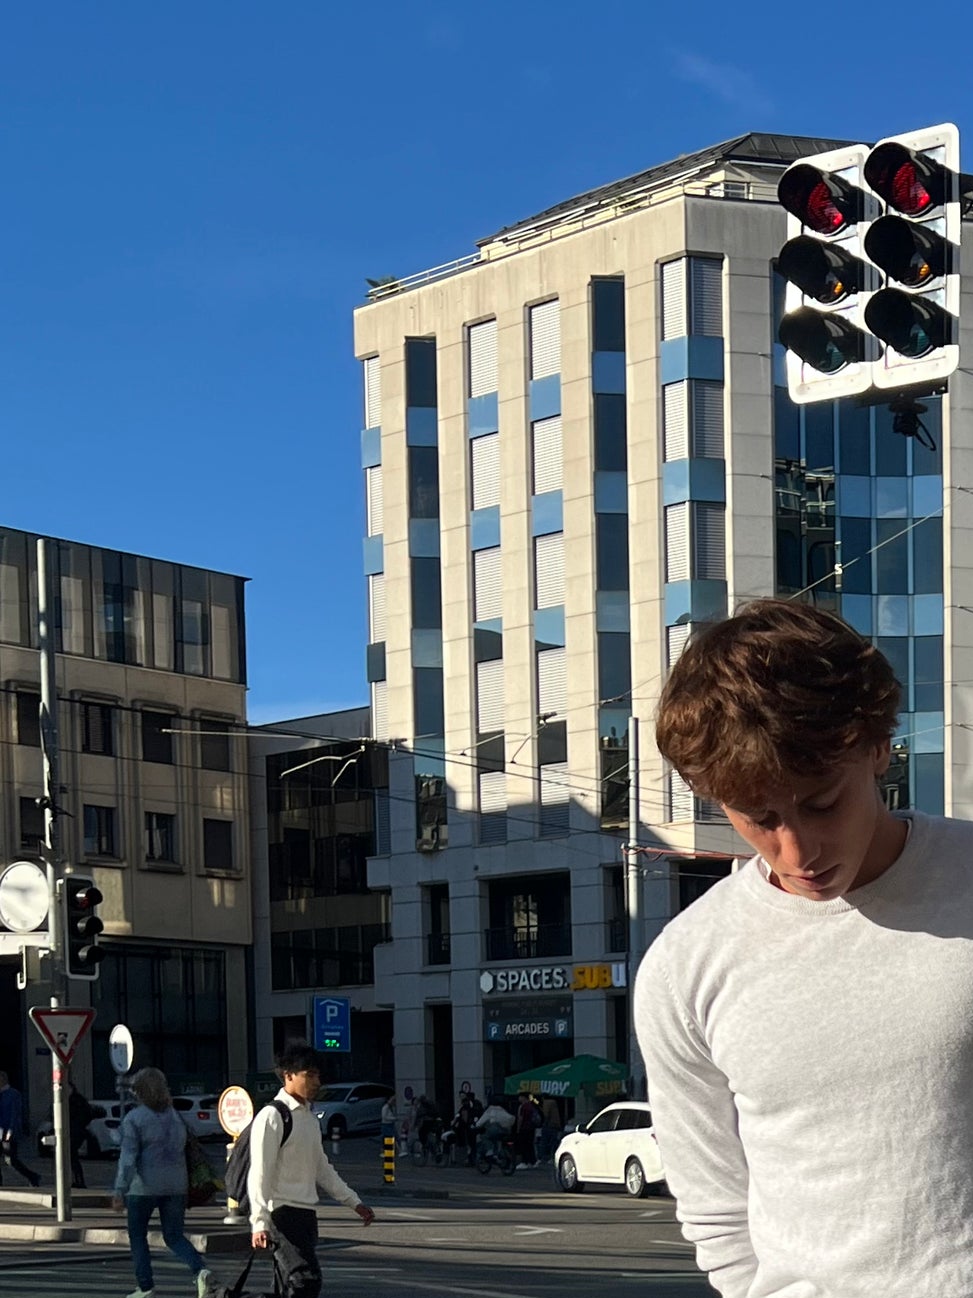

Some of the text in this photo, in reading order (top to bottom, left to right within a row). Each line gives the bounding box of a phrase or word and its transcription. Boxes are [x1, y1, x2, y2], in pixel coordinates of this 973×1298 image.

[326, 1005, 338, 1023] P
[505, 1022, 550, 1035] ARCADES
[519, 1080, 571, 1096] SUBWAY
